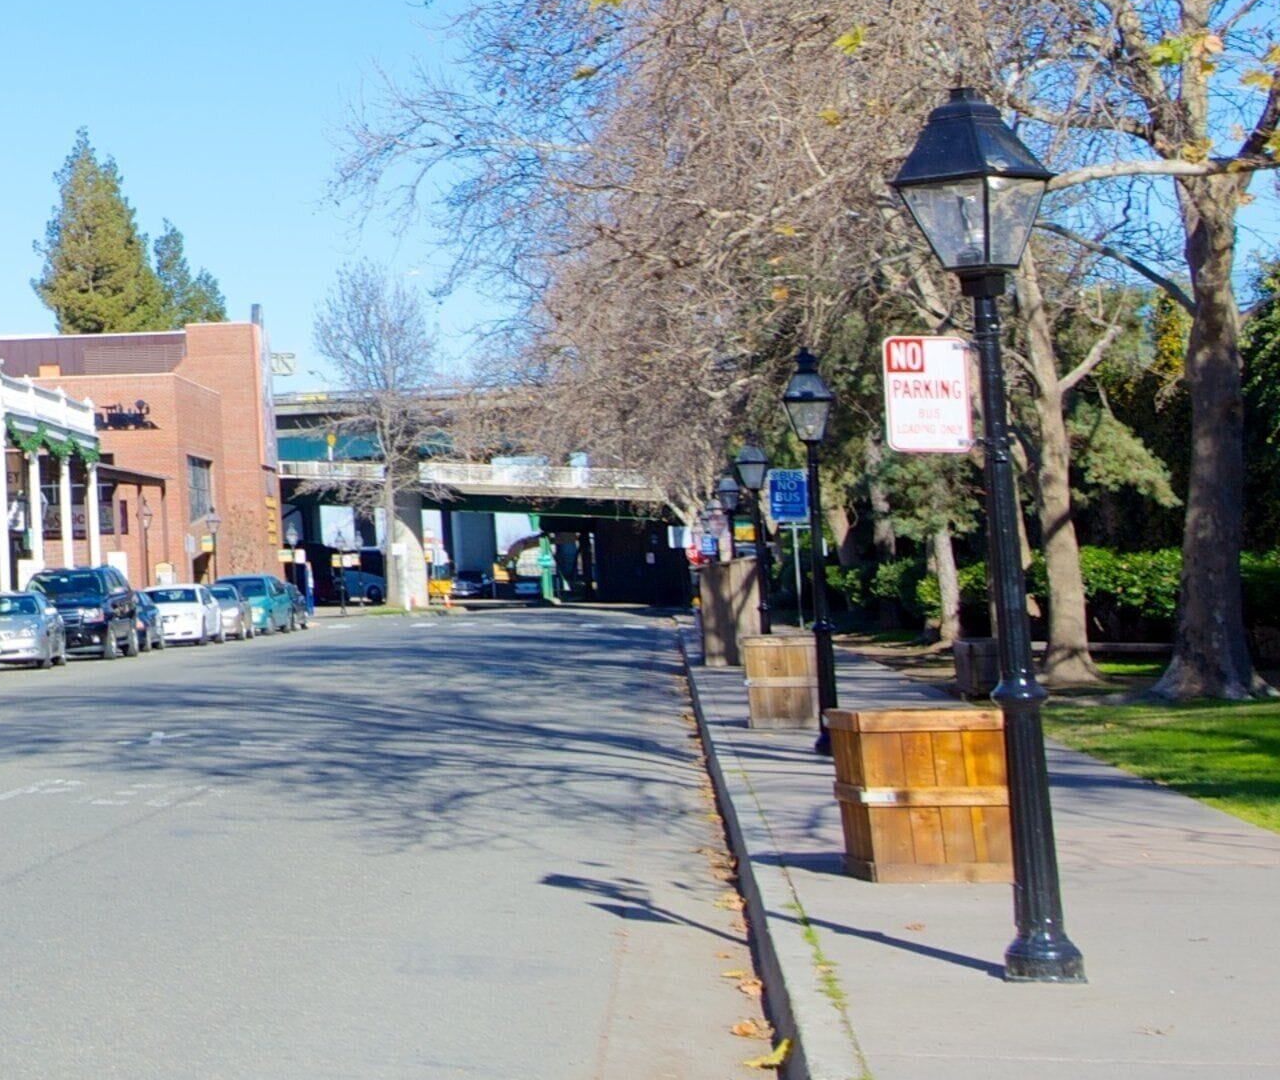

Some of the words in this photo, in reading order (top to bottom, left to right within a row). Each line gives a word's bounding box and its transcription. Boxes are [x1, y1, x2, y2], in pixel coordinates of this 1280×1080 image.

[890, 341, 922, 371] NO
[892, 379, 962, 400] PARKING
[917, 408, 941, 419] BUS
[897, 424, 937, 435] LOADING
[777, 480, 798, 491] NO
[775, 491, 801, 502] BUS
